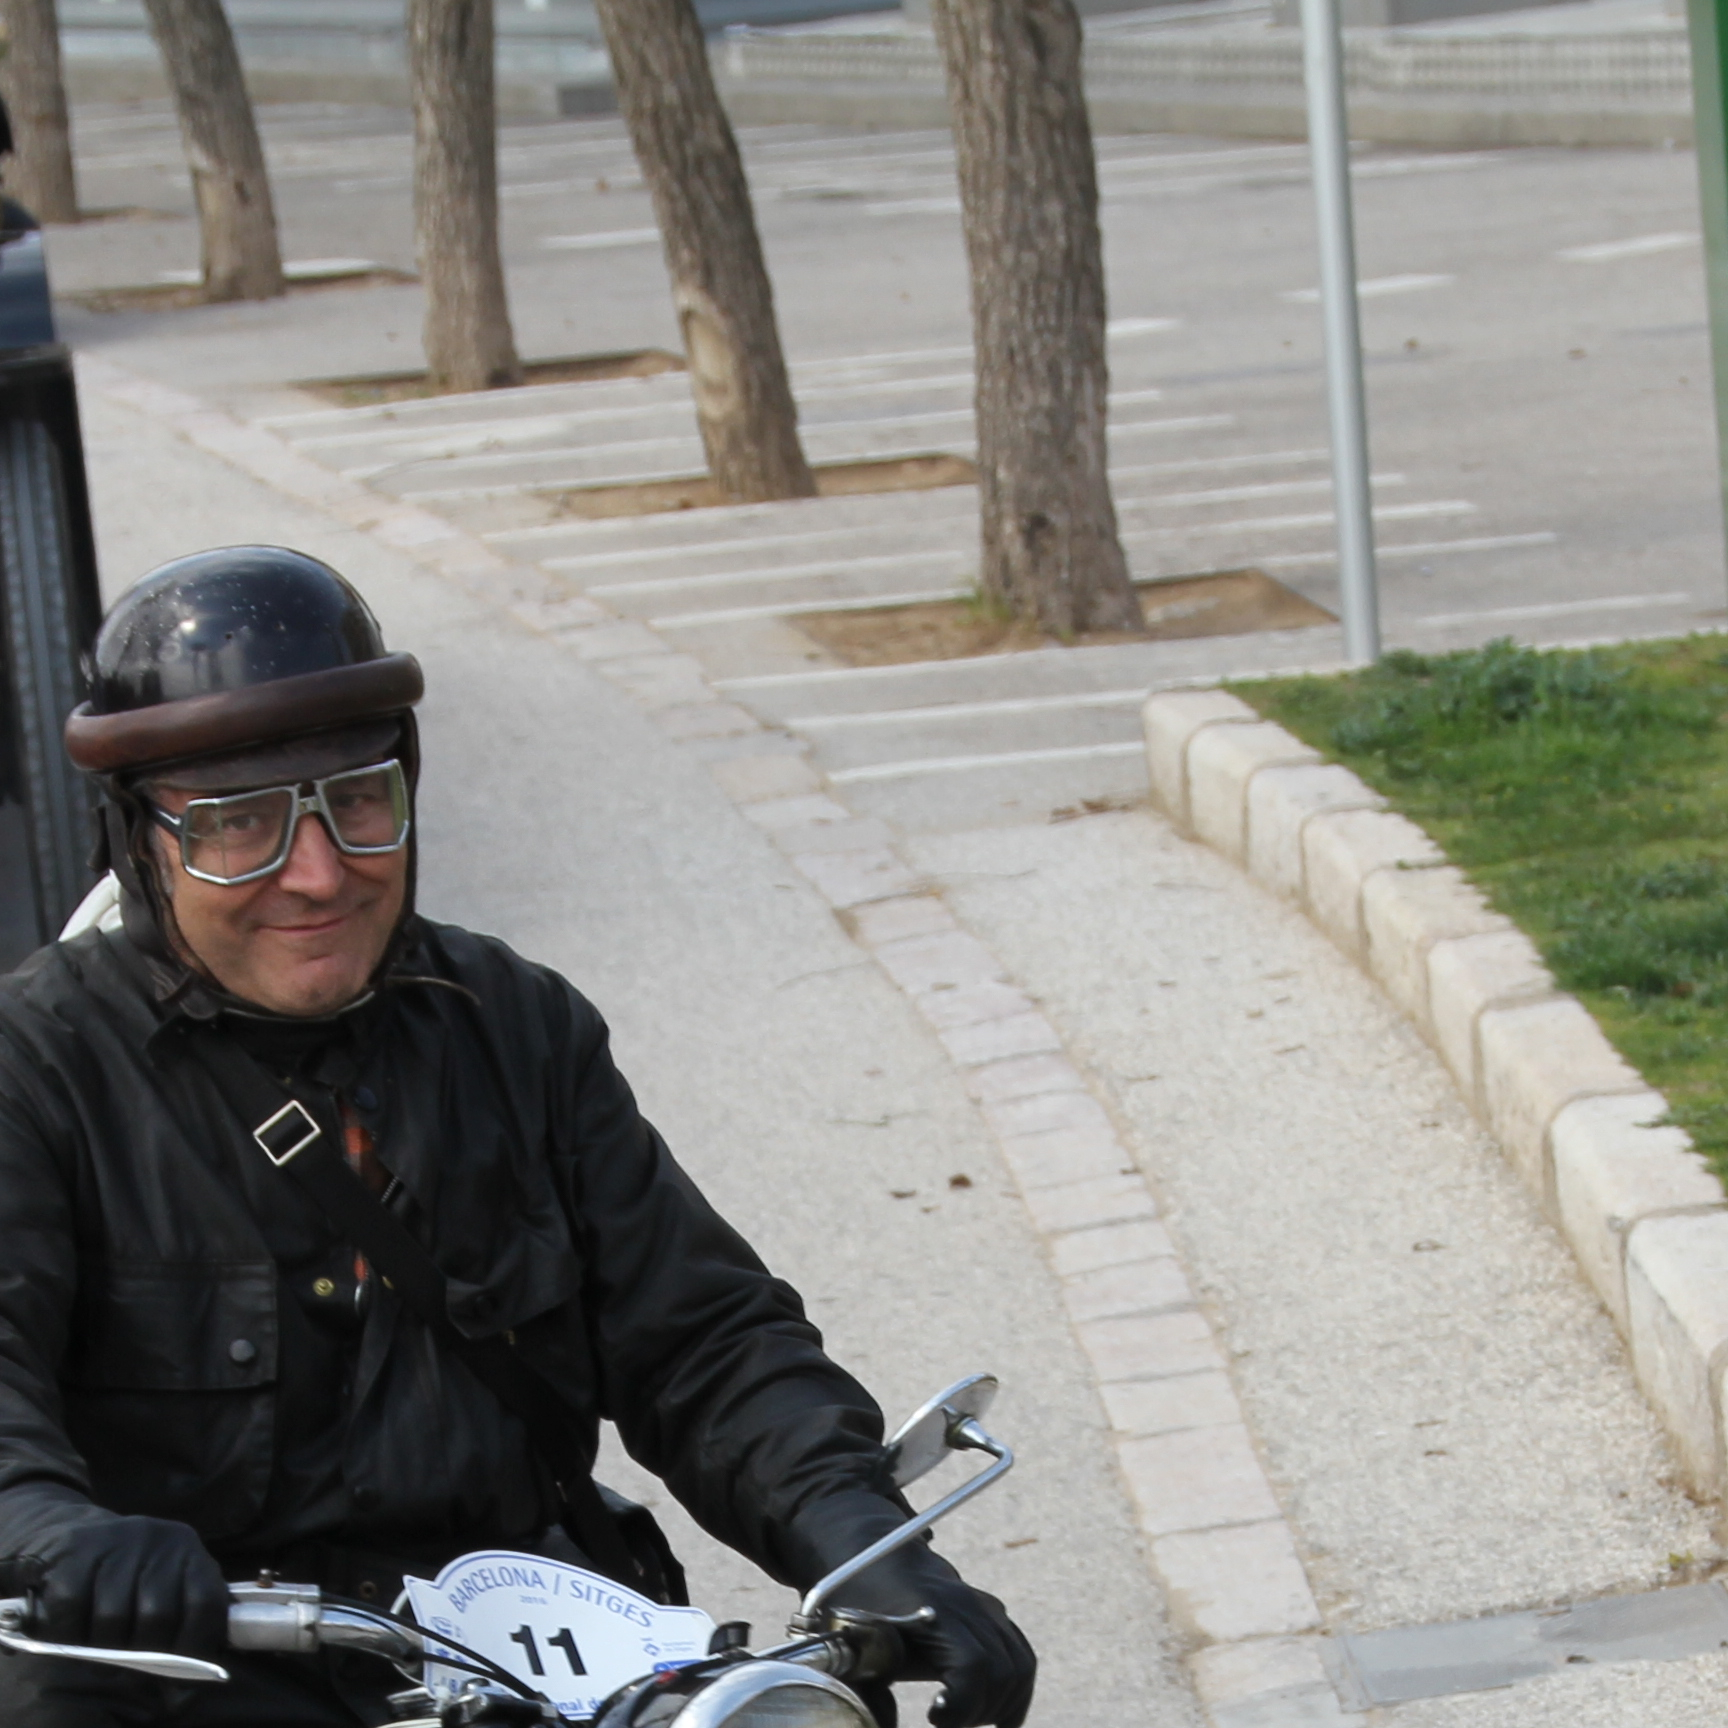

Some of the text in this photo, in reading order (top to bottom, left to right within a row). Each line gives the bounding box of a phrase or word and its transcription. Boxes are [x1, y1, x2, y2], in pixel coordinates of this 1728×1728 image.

[447, 1565, 548, 1615] BARCELONA
[569, 1579, 656, 1629] SITGES
[508, 1623, 589, 1677] 11
